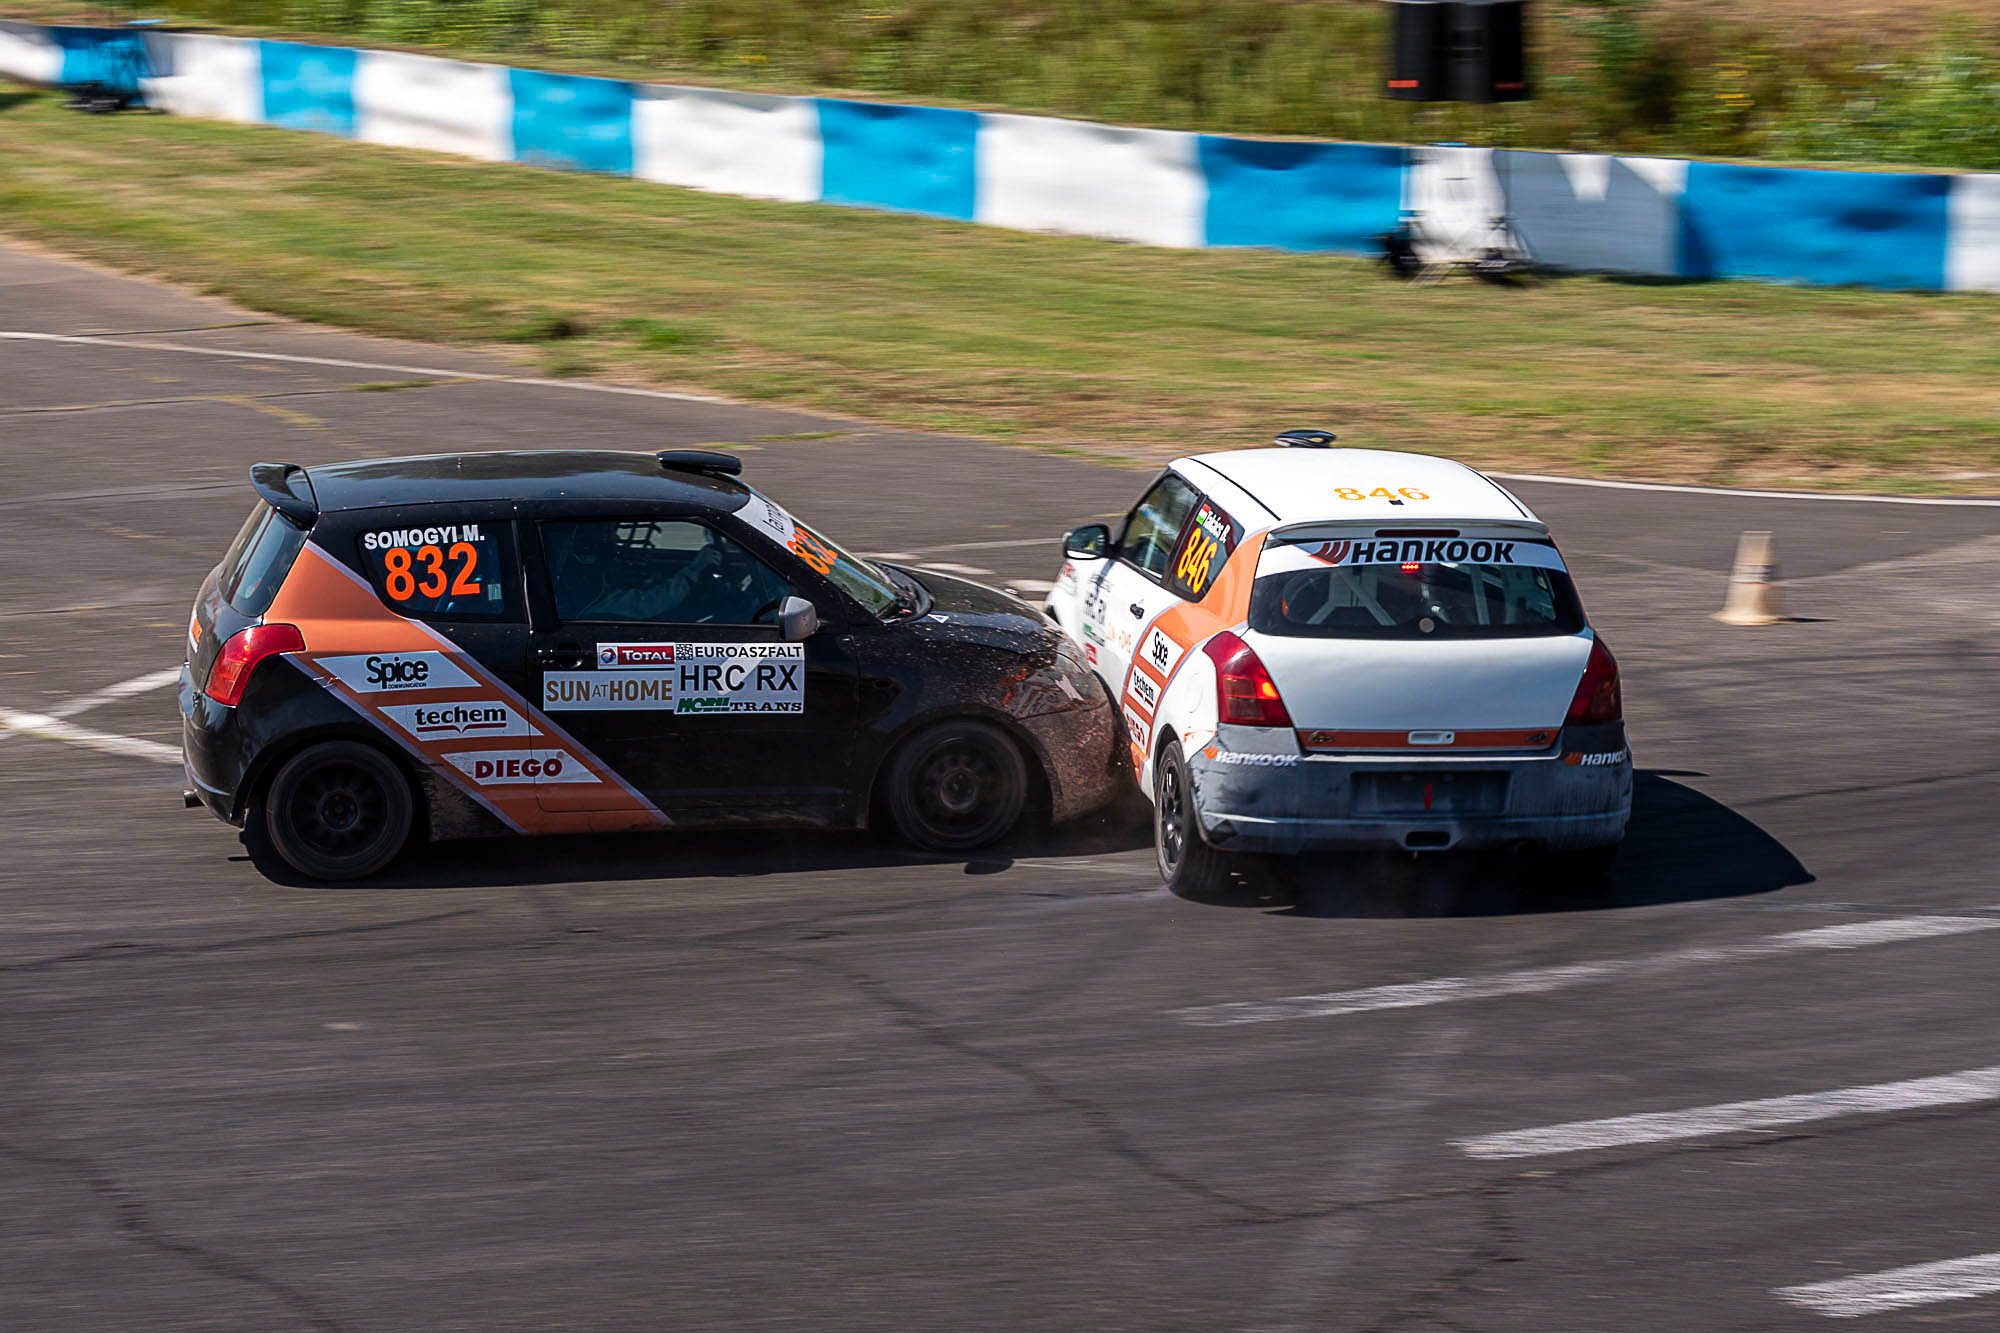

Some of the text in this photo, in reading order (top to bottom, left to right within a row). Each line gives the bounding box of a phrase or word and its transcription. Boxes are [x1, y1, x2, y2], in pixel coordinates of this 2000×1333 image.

[1333, 487, 1430, 501] 846
[364, 524, 485, 550] SOMOGYI M.
[786, 526, 838, 575] 832
[384, 541, 481, 601] 832
[1177, 527, 1218, 594] 846
[694, 646, 802, 658] EUROASZFALT
[1152, 631, 1169, 667] Spice
[366, 656, 429, 690] Spice
[680, 664, 798, 692] HRC RX
[1133, 669, 1154, 702] techem
[415, 706, 507, 726] techem
[730, 702, 803, 712] TRANS
[474, 758, 563, 779] DIEGO
